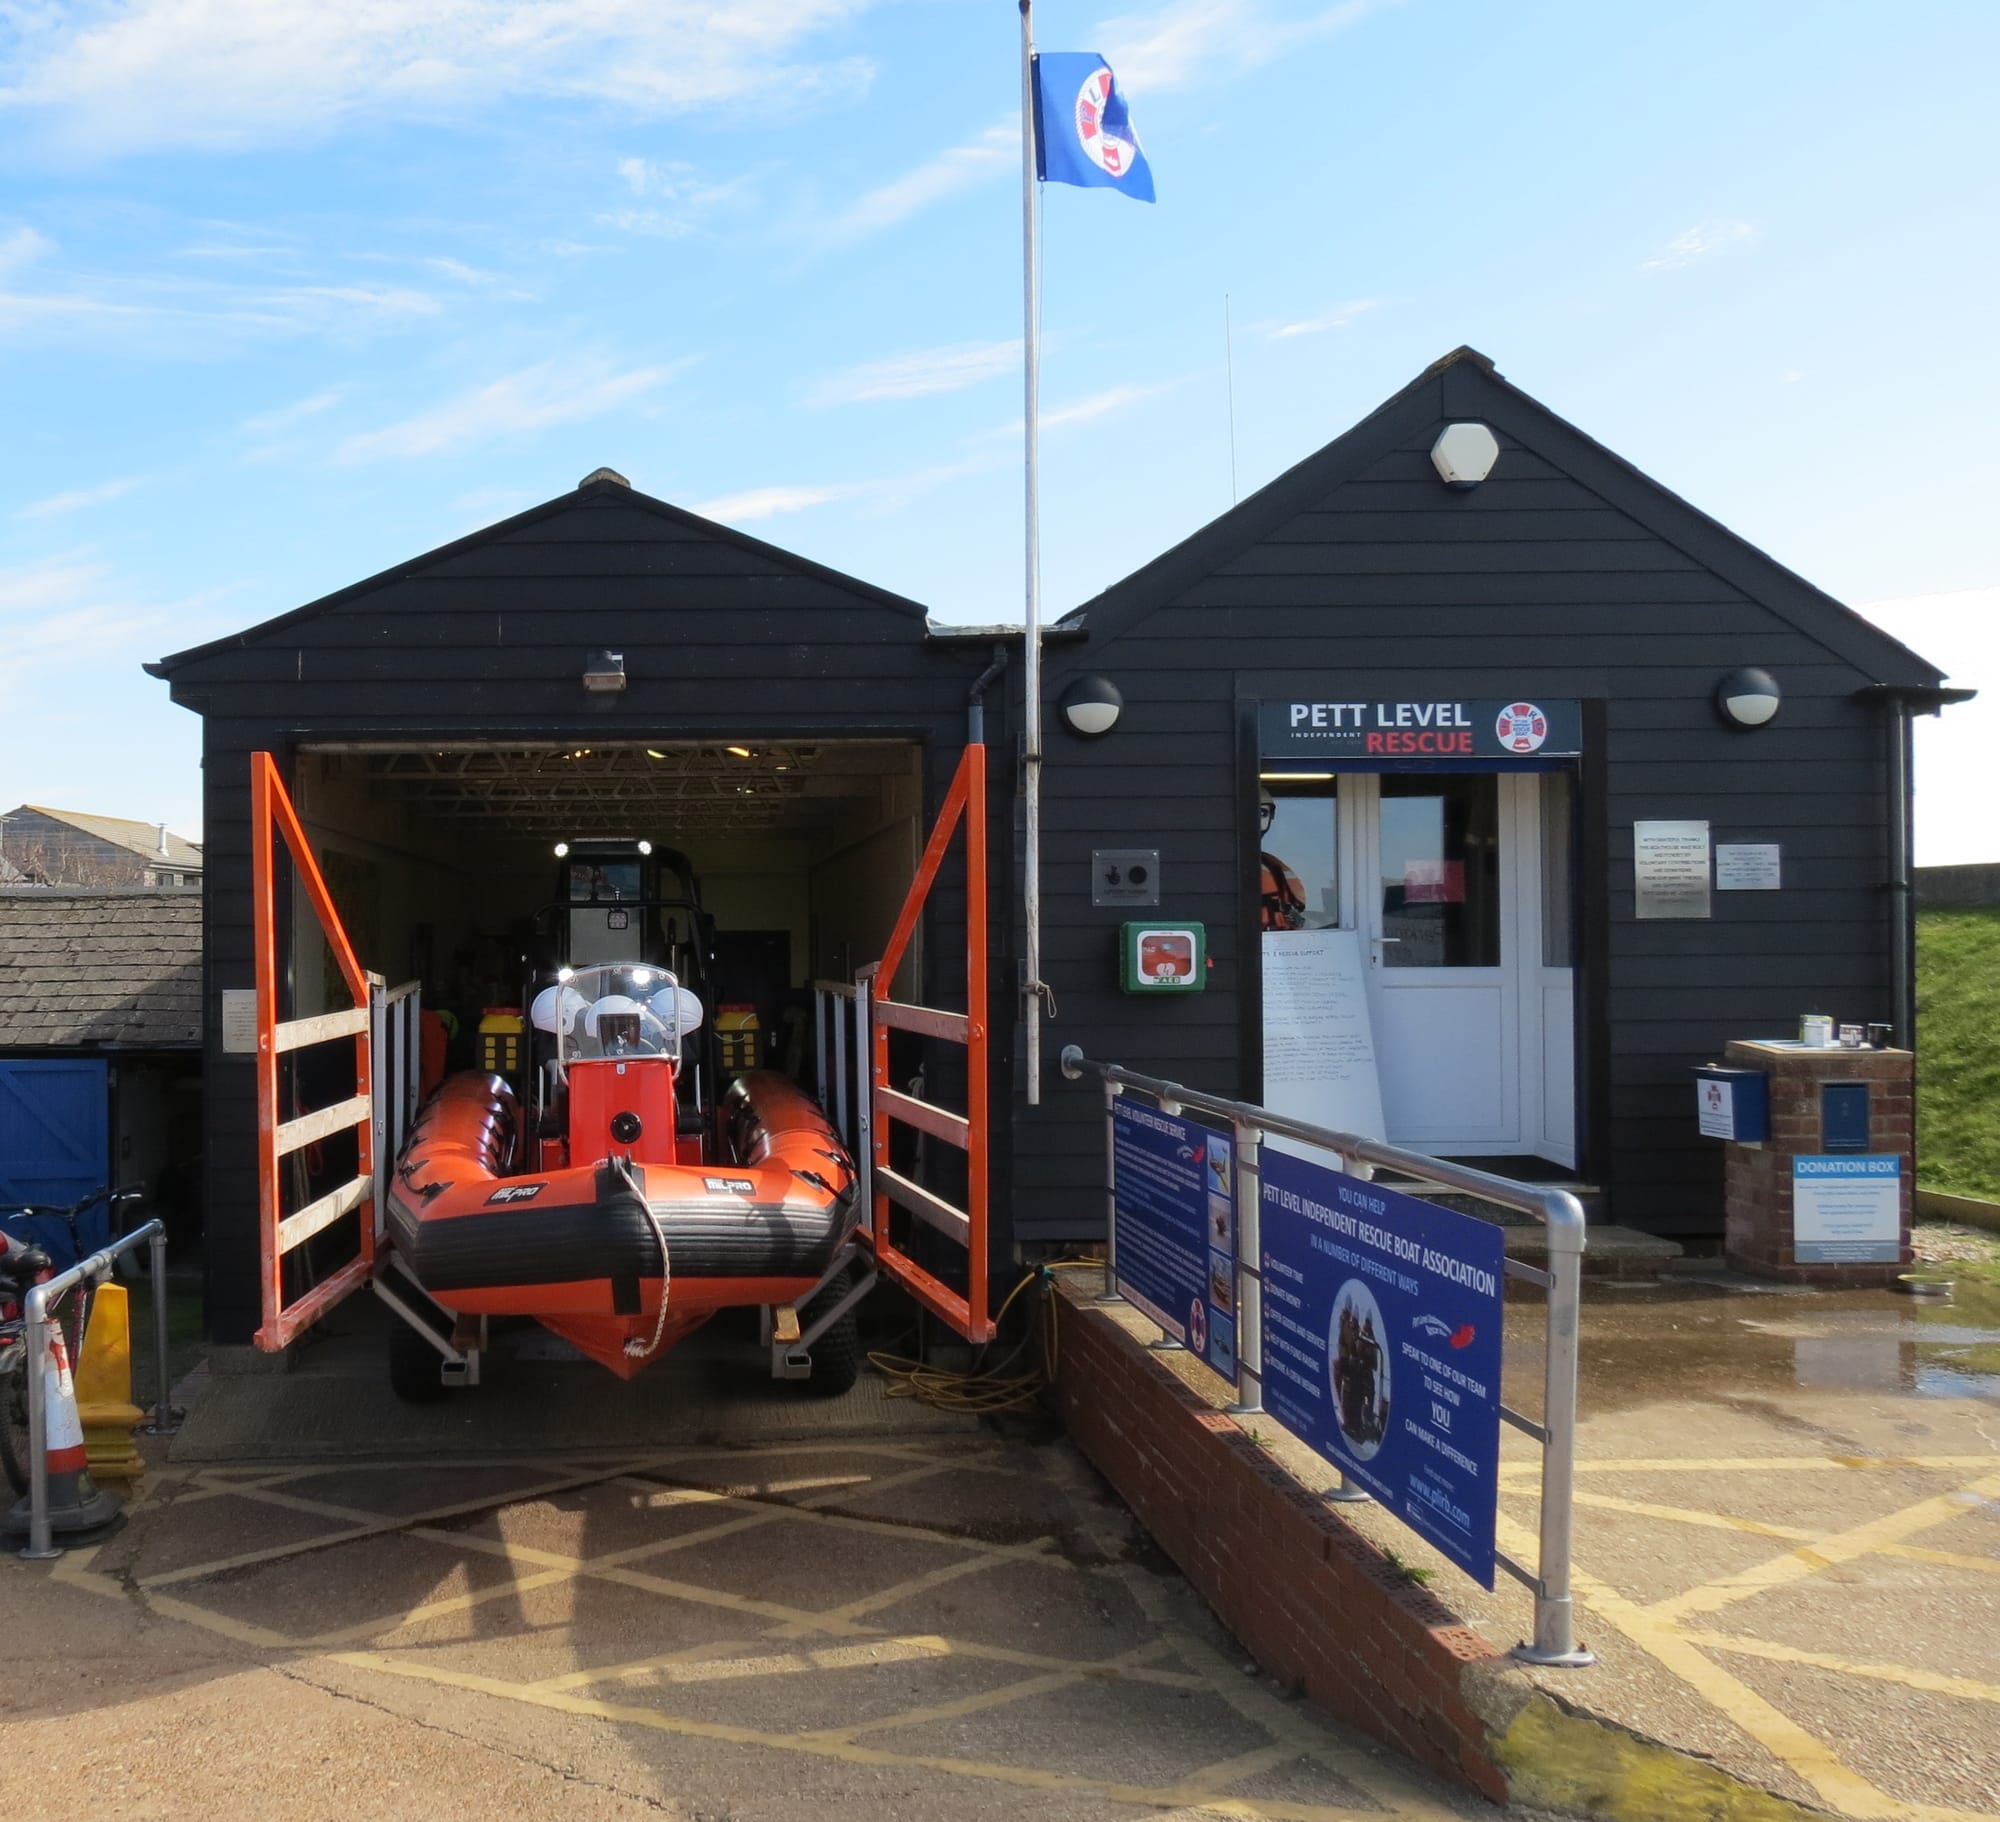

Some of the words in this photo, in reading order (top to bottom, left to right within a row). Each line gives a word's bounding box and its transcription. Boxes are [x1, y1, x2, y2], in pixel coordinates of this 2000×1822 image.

[1290, 703, 1367, 727] PETT
[1377, 703, 1472, 727] LEVEL
[1367, 732, 1473, 753] RESCUE
[1797, 1161, 1865, 1173] DONATION
[1868, 1161, 1895, 1173] BOX
[1338, 1185, 1351, 1204] YOU
[1352, 1190, 1367, 1210] CAN
[1368, 1196, 1385, 1217] HELP
[1263, 1182, 1278, 1205] PETT
[1280, 1189, 1300, 1214] LEVEL
[1302, 1198, 1355, 1238] INDEPENDENT
[1359, 1220, 1391, 1253] RESCUE
[1395, 1235, 1419, 1265] BOAT
[1422, 1246, 1494, 1297] ASSOCIATION
[1323, 1238, 1348, 1264] NUMBER
[1350, 1250, 1359, 1269] OF
[1361, 1255, 1396, 1287] DIFFERENT
[1397, 1272, 1418, 1297] WAYS
[1402, 1341, 1419, 1362] SPEAK
[1420, 1351, 1428, 1367] TO
[1429, 1356, 1441, 1375] ONE
[1442, 1363, 1451, 1380] OF
[1452, 1368, 1466, 1388] OUR
[1467, 1376, 1486, 1400] TEAM
[1424, 1374, 1431, 1390] TO
[1432, 1379, 1442, 1397] SEE
[1443, 1386, 1460, 1407] HOW
[1431, 1400, 1449, 1428] YOU
[1405, 1417, 1416, 1437] CAN
[1418, 1425, 1434, 1449] MAKE
[1435, 1436, 1440, 1452] A
[1409, 1473, 1471, 1528] www.plirb.com
